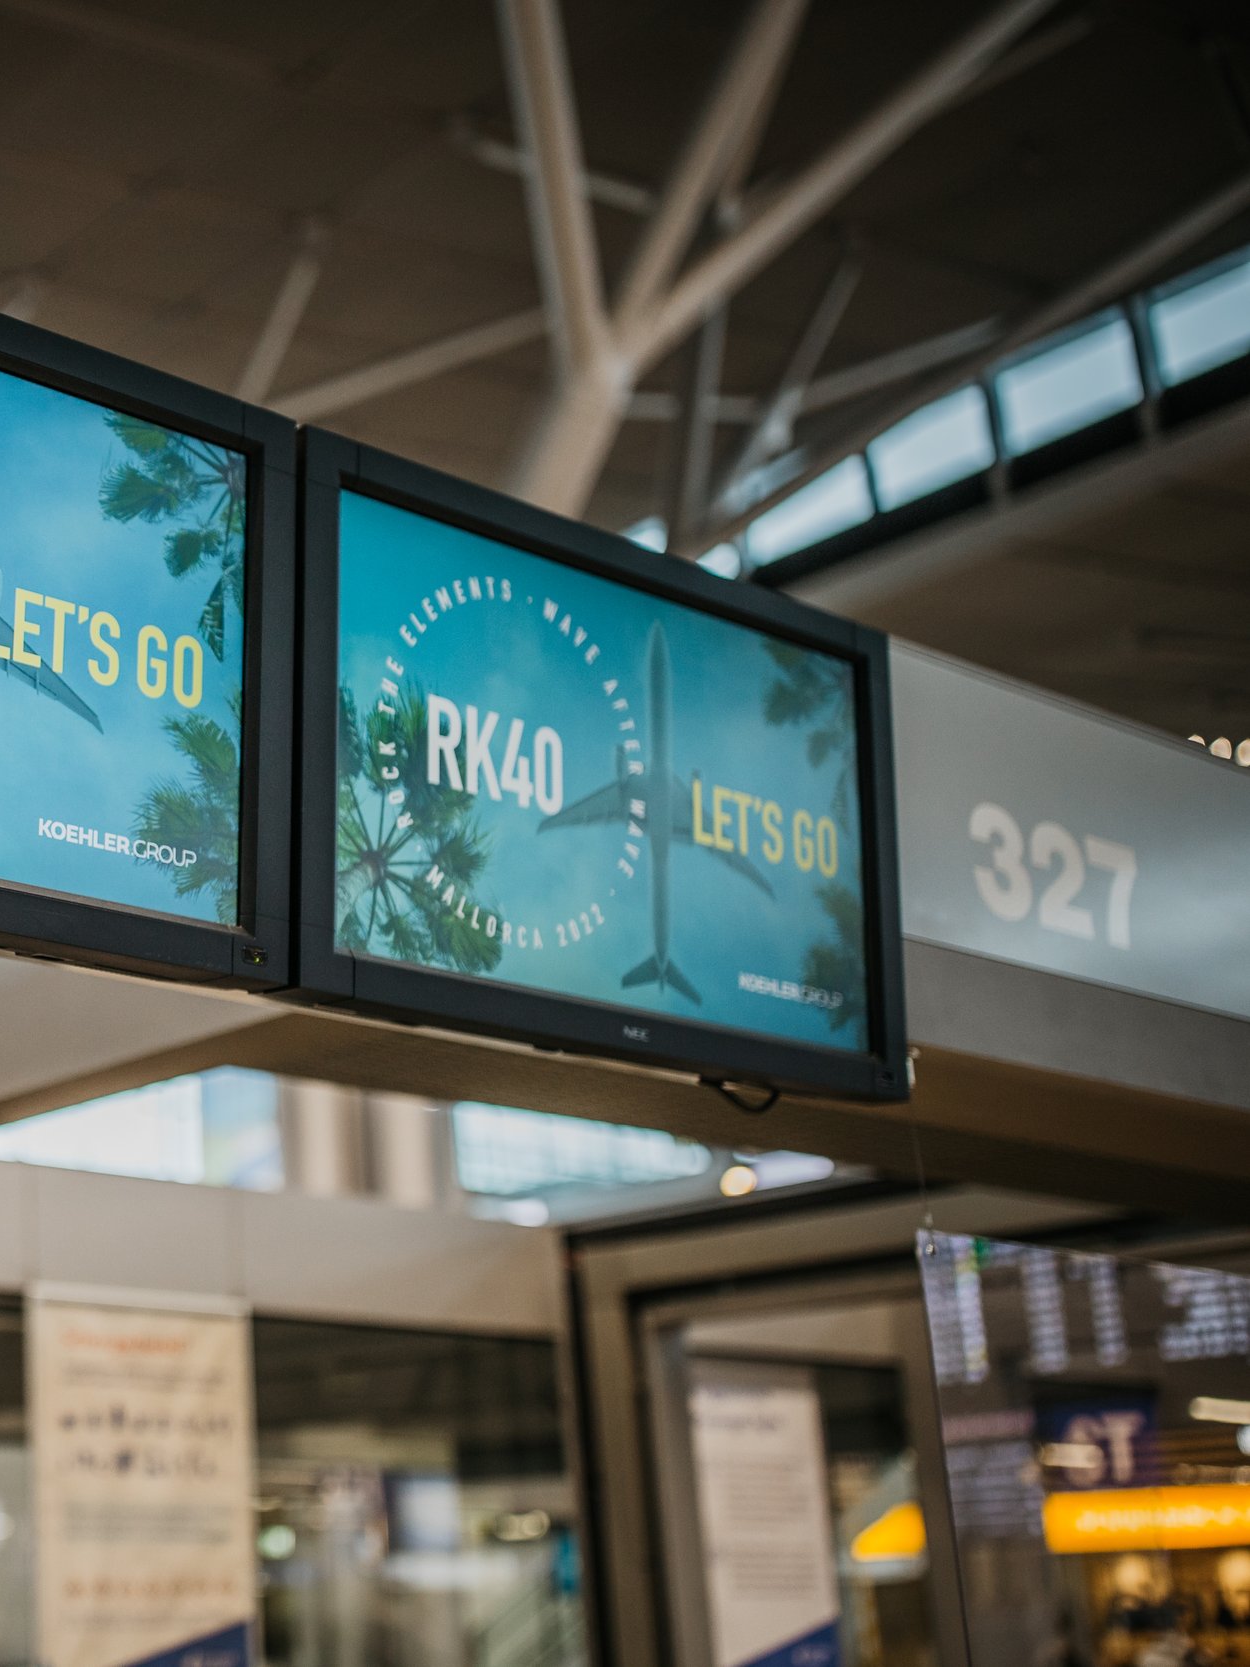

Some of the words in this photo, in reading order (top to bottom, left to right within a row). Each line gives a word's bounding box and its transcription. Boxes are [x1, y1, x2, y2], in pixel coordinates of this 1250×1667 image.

[399, 575, 513, 648] ELEMENTS
[542, 597, 601, 666] WAVE
[136, 624, 204, 709] GO
[378, 655, 405, 716] THE
[426, 692, 564, 817] RK40
[603, 677, 646, 776] AFTER
[378, 740, 414, 829] ROCK
[691, 777, 784, 865] LET'S
[791, 808, 839, 879] GO
[617, 798, 647, 879] WAVE
[968, 801, 1138, 951] 327
[425, 863, 544, 950] MALLORCA
[555, 902, 606, 948] 2022
